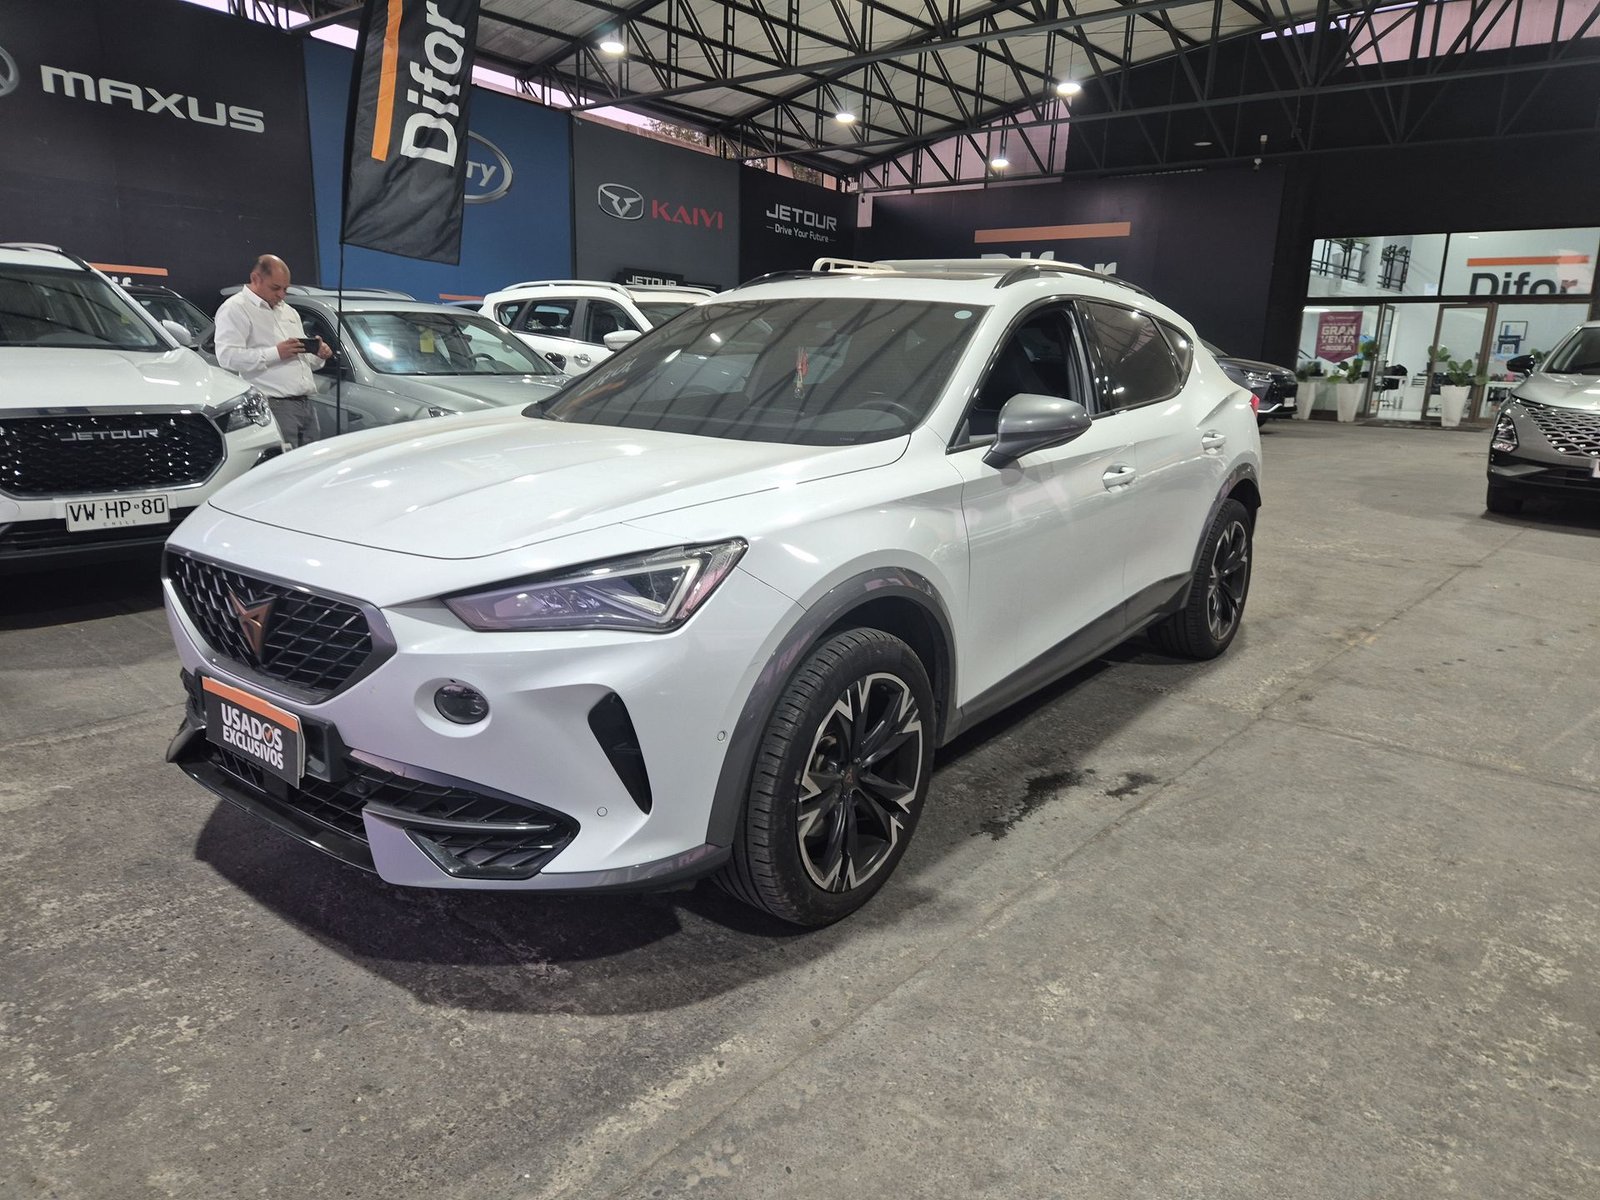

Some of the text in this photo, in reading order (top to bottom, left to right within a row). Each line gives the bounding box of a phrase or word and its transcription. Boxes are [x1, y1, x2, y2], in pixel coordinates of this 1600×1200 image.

[400, 0, 466, 167] Difor
[40, 65, 265, 133] MAXUS
[766, 203, 837, 231] JETOUR
[774, 223, 829, 243] Drive Your Future
[626, 275, 677, 286] JETOUR
[1469, 271, 1578, 295] Difor
[1321, 325, 1356, 336] GRAN
[1321, 335, 1355, 344] VENTA
[60, 428, 159, 441] JETOUR
[221, 702, 283, 752] USADOS
[222, 724, 284, 770] EXCLUSIVOS
